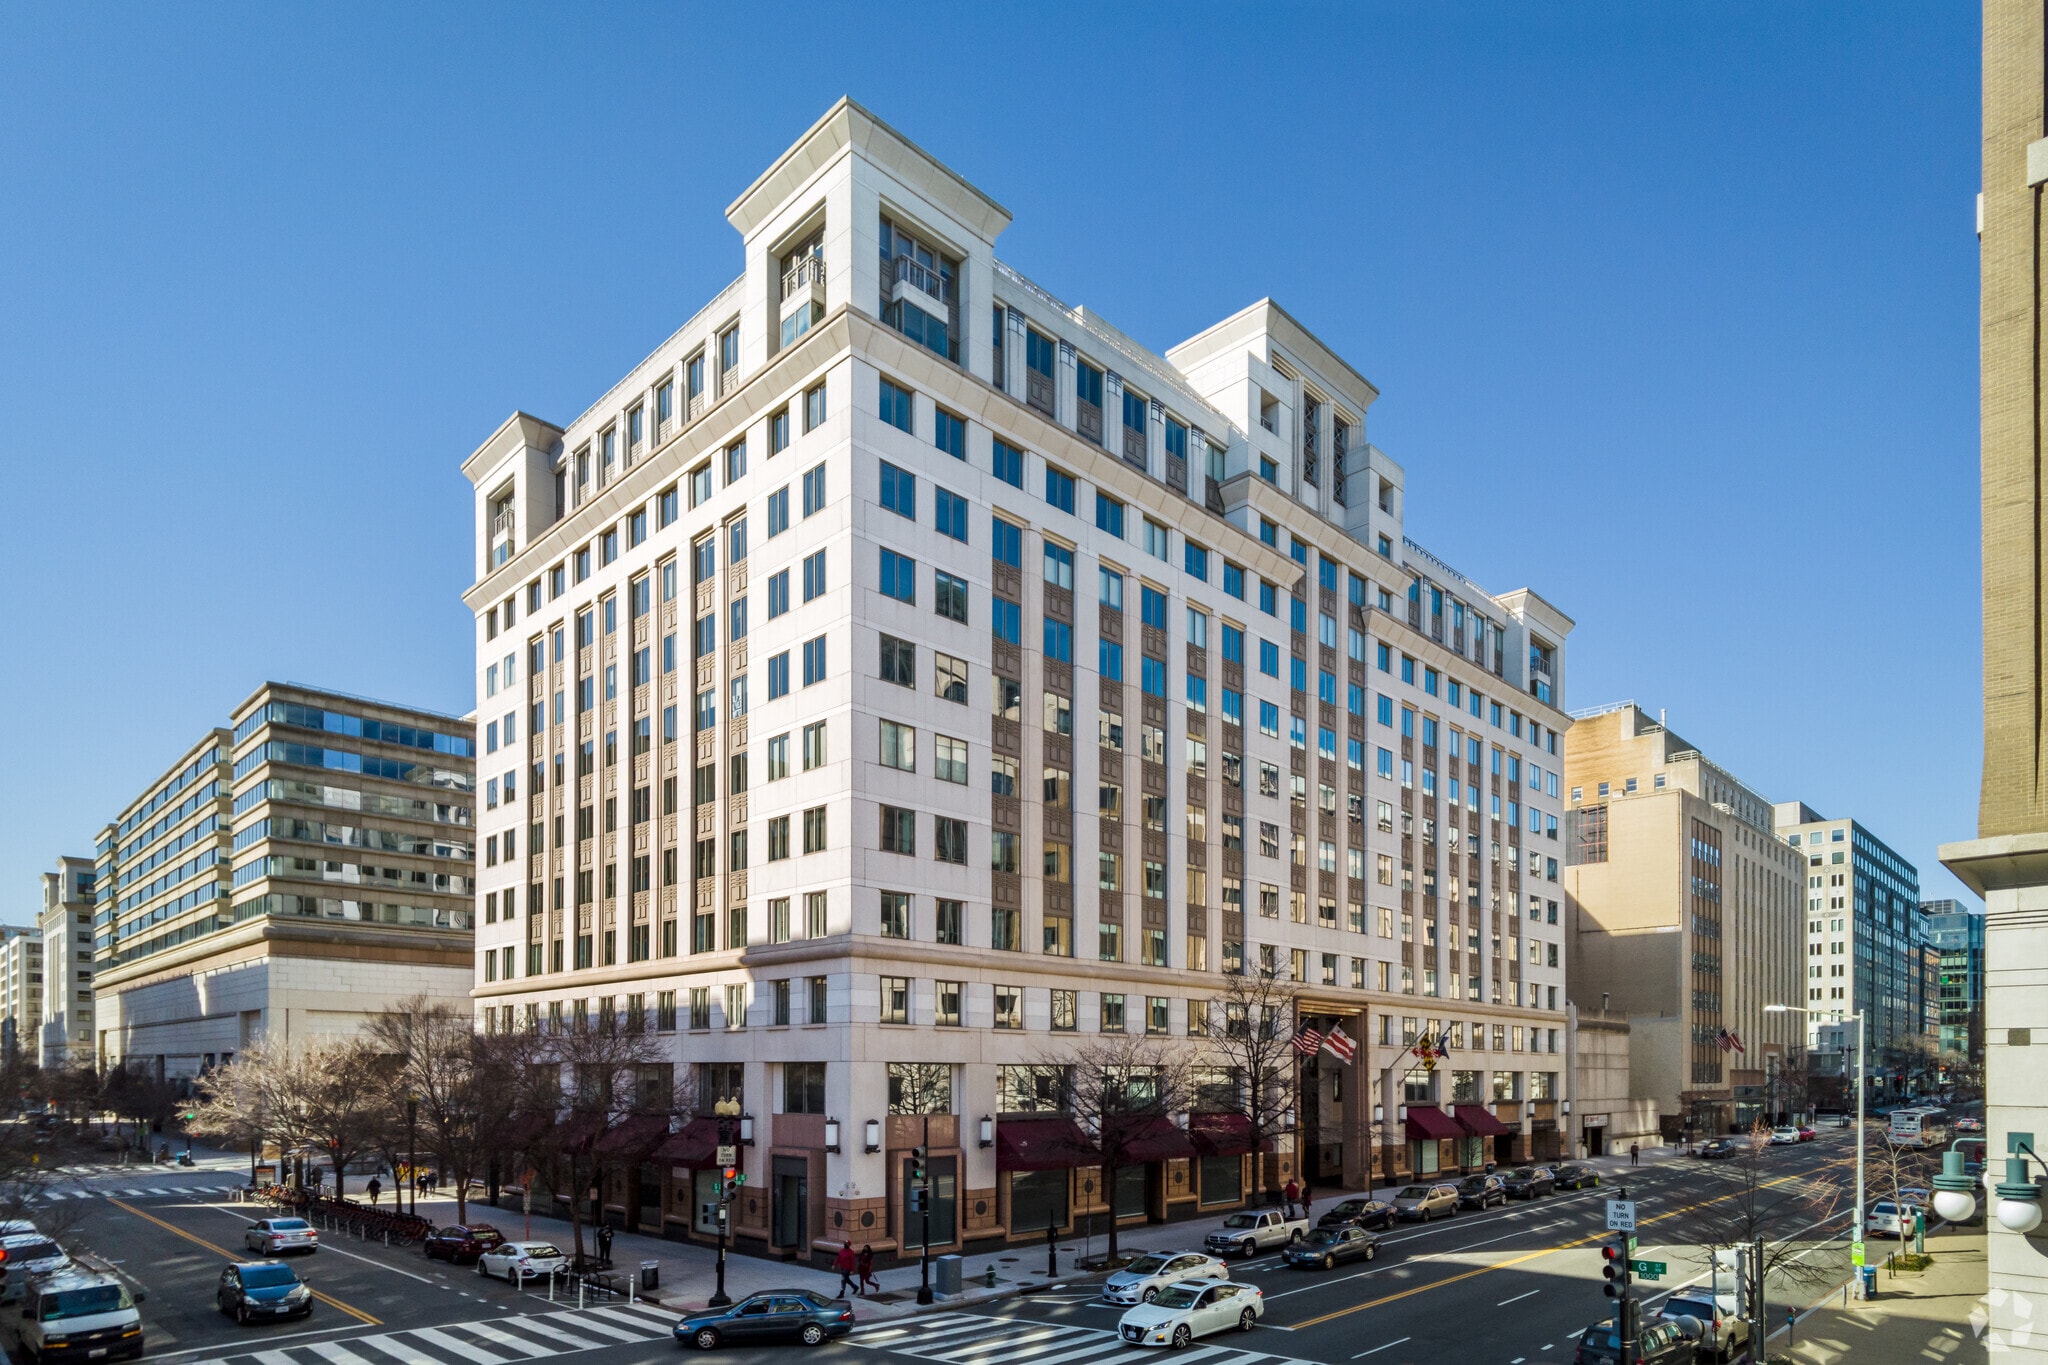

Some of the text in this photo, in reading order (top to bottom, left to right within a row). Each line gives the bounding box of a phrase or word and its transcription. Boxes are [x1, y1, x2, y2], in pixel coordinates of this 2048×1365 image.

[1613, 1211, 1630, 1219] TURN
[1620, 1220, 1633, 1228] RED
[1638, 1262, 1648, 1272] G
